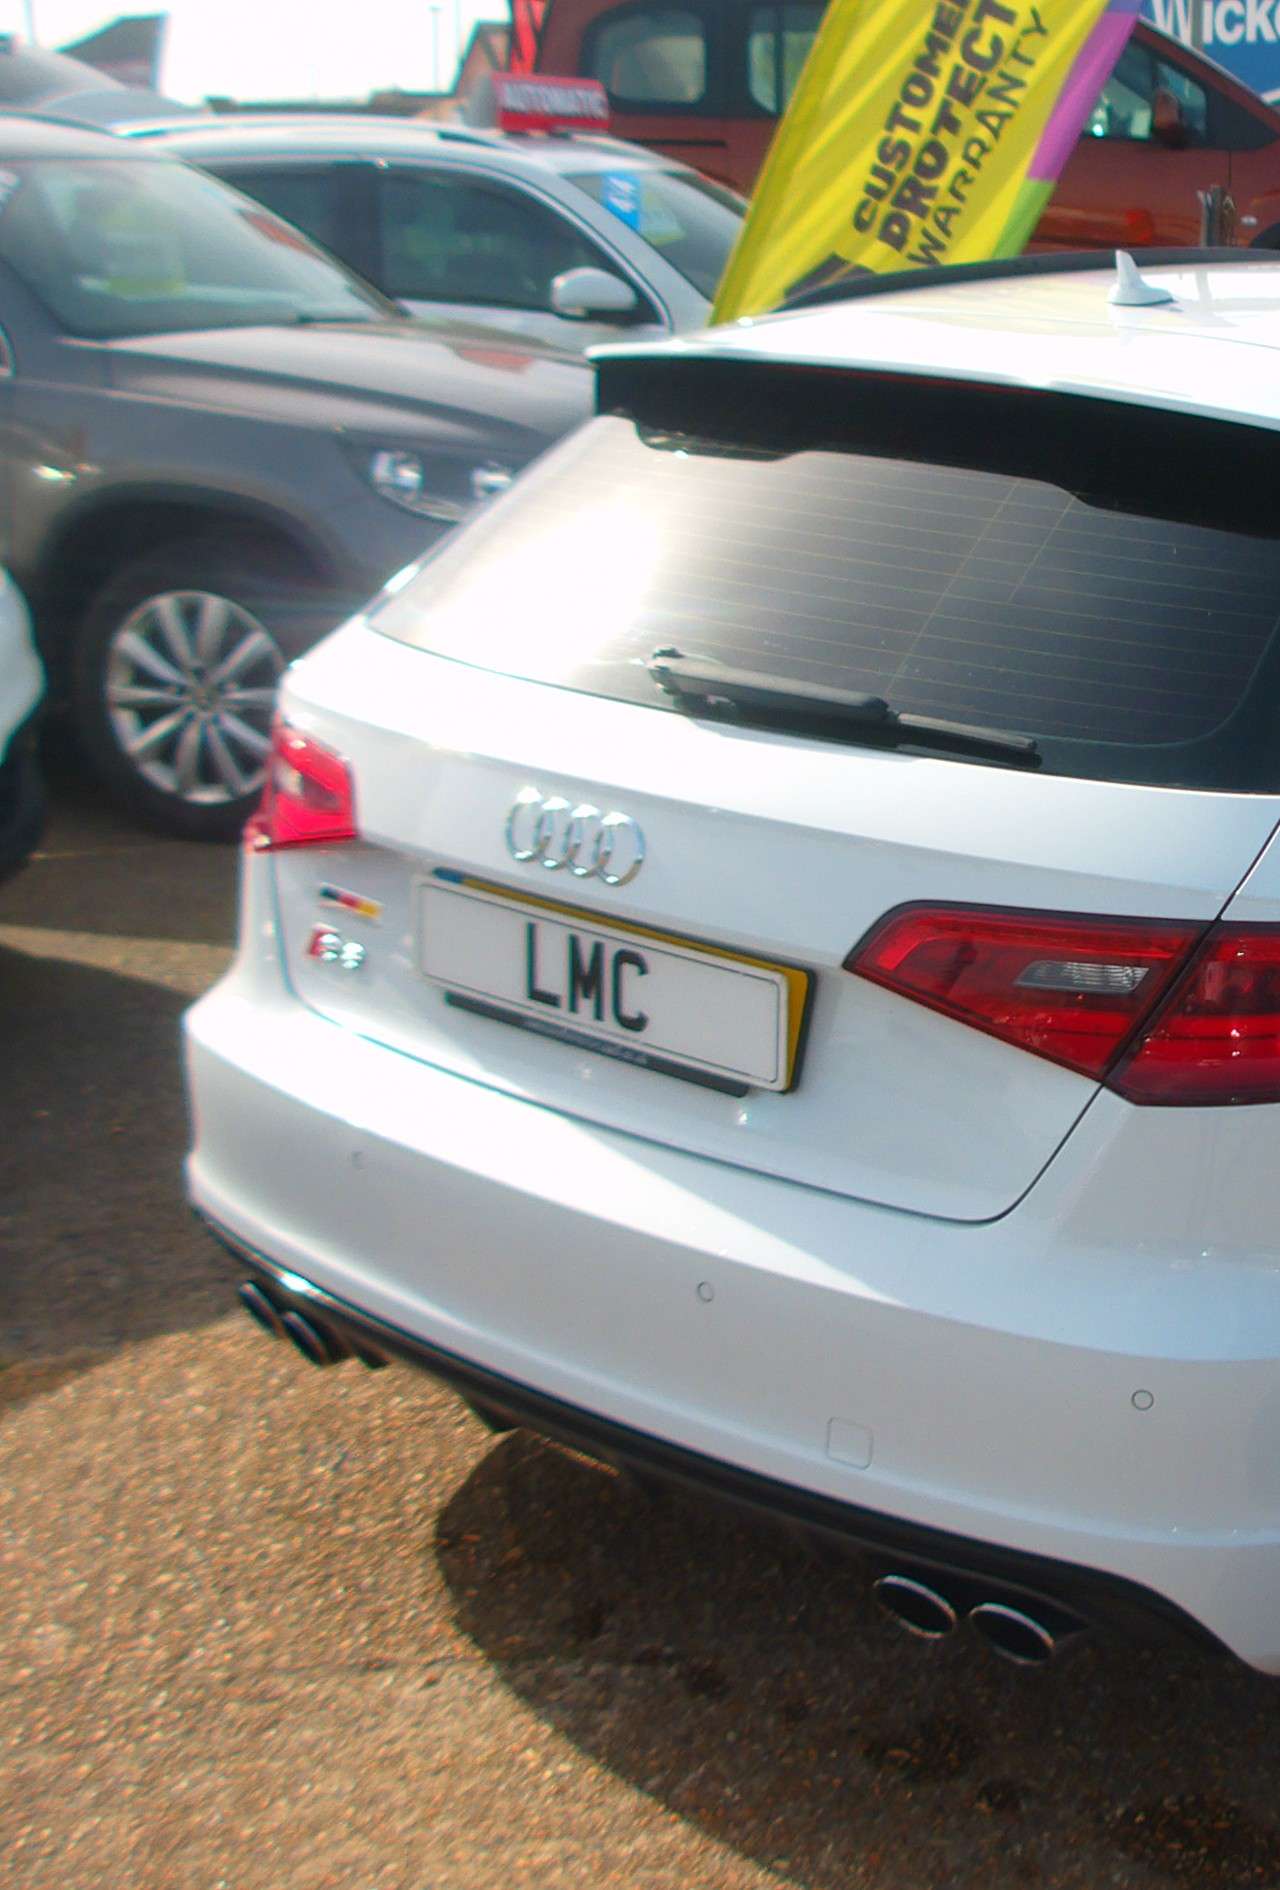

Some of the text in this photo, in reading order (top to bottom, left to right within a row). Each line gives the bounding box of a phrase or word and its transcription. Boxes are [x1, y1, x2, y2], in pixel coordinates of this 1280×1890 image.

[877, 0, 1017, 252] PROTECT
[907, 6, 1048, 267] WARRANTY
[524, 921, 648, 1033] LMC
